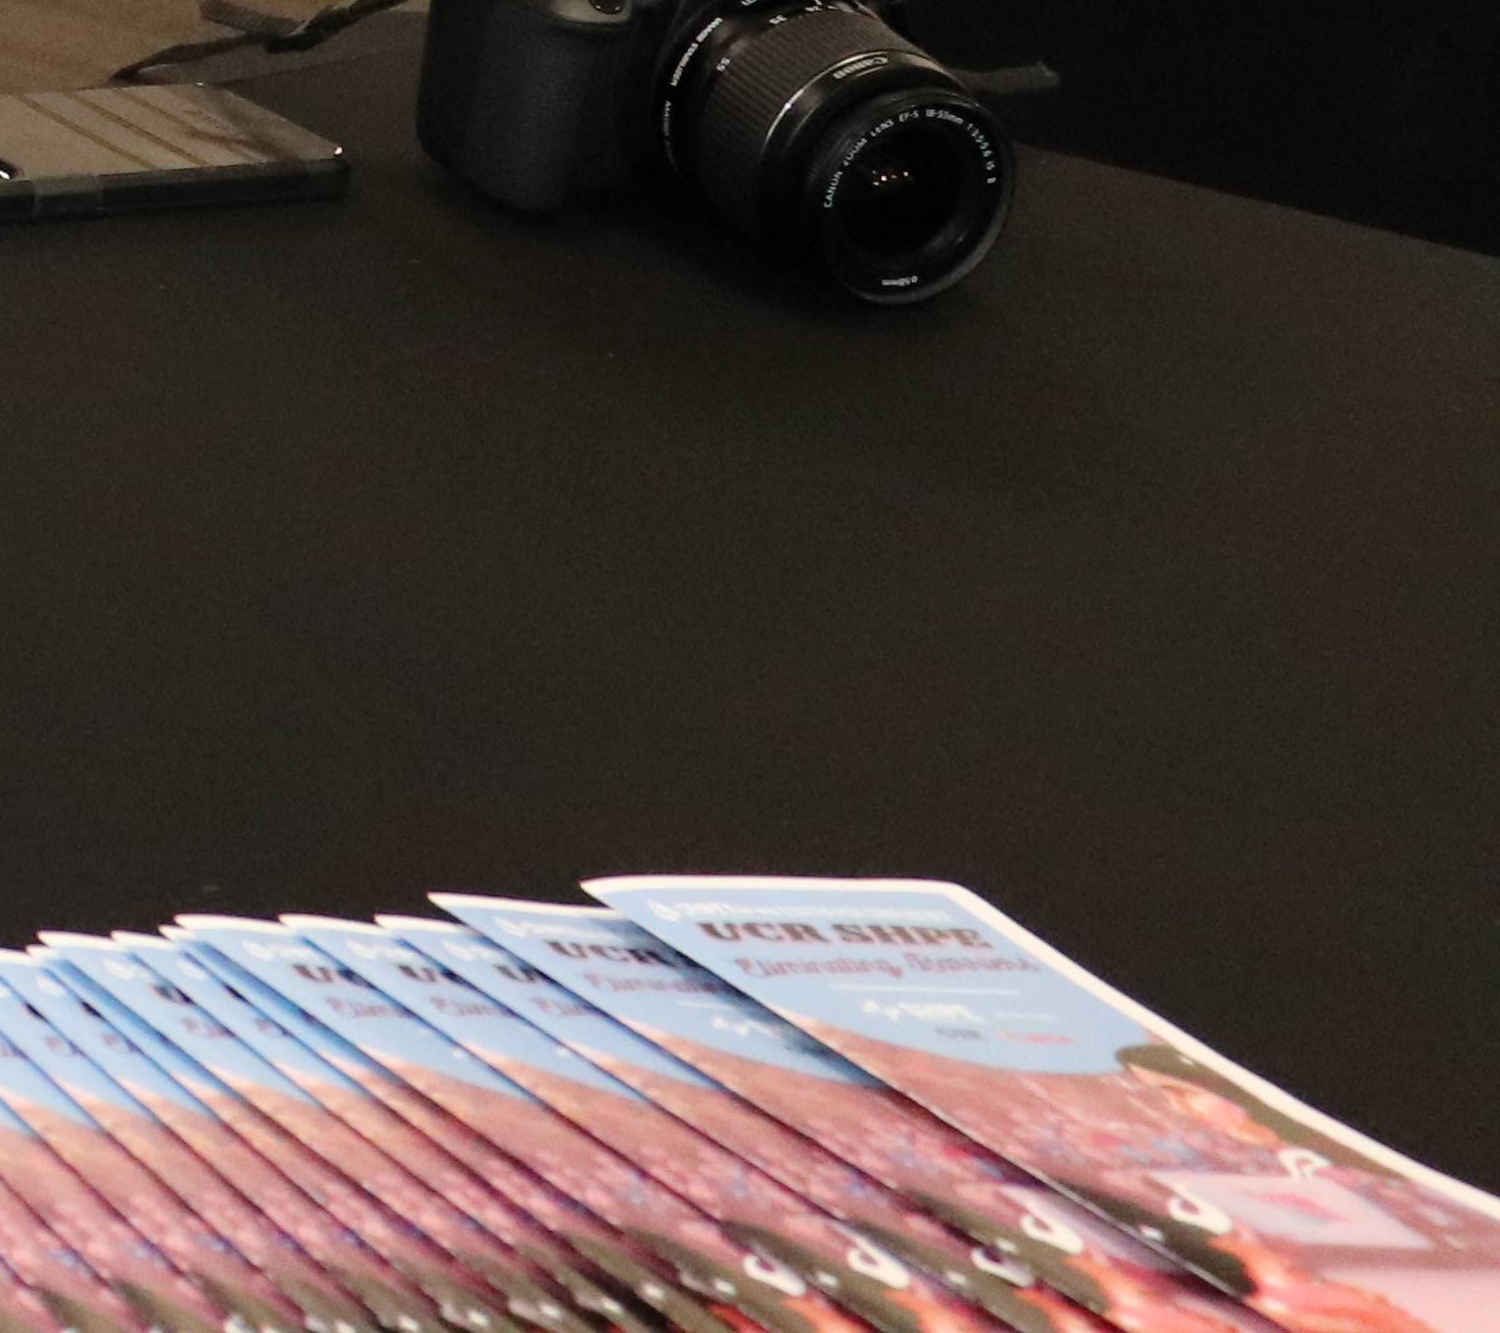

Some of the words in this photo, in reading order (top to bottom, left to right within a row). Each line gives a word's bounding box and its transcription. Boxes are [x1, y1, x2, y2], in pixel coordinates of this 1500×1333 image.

[832, 56, 890, 80] Canon
[696, 921, 830, 946] UCR
[831, 923, 993, 950] SHPE
